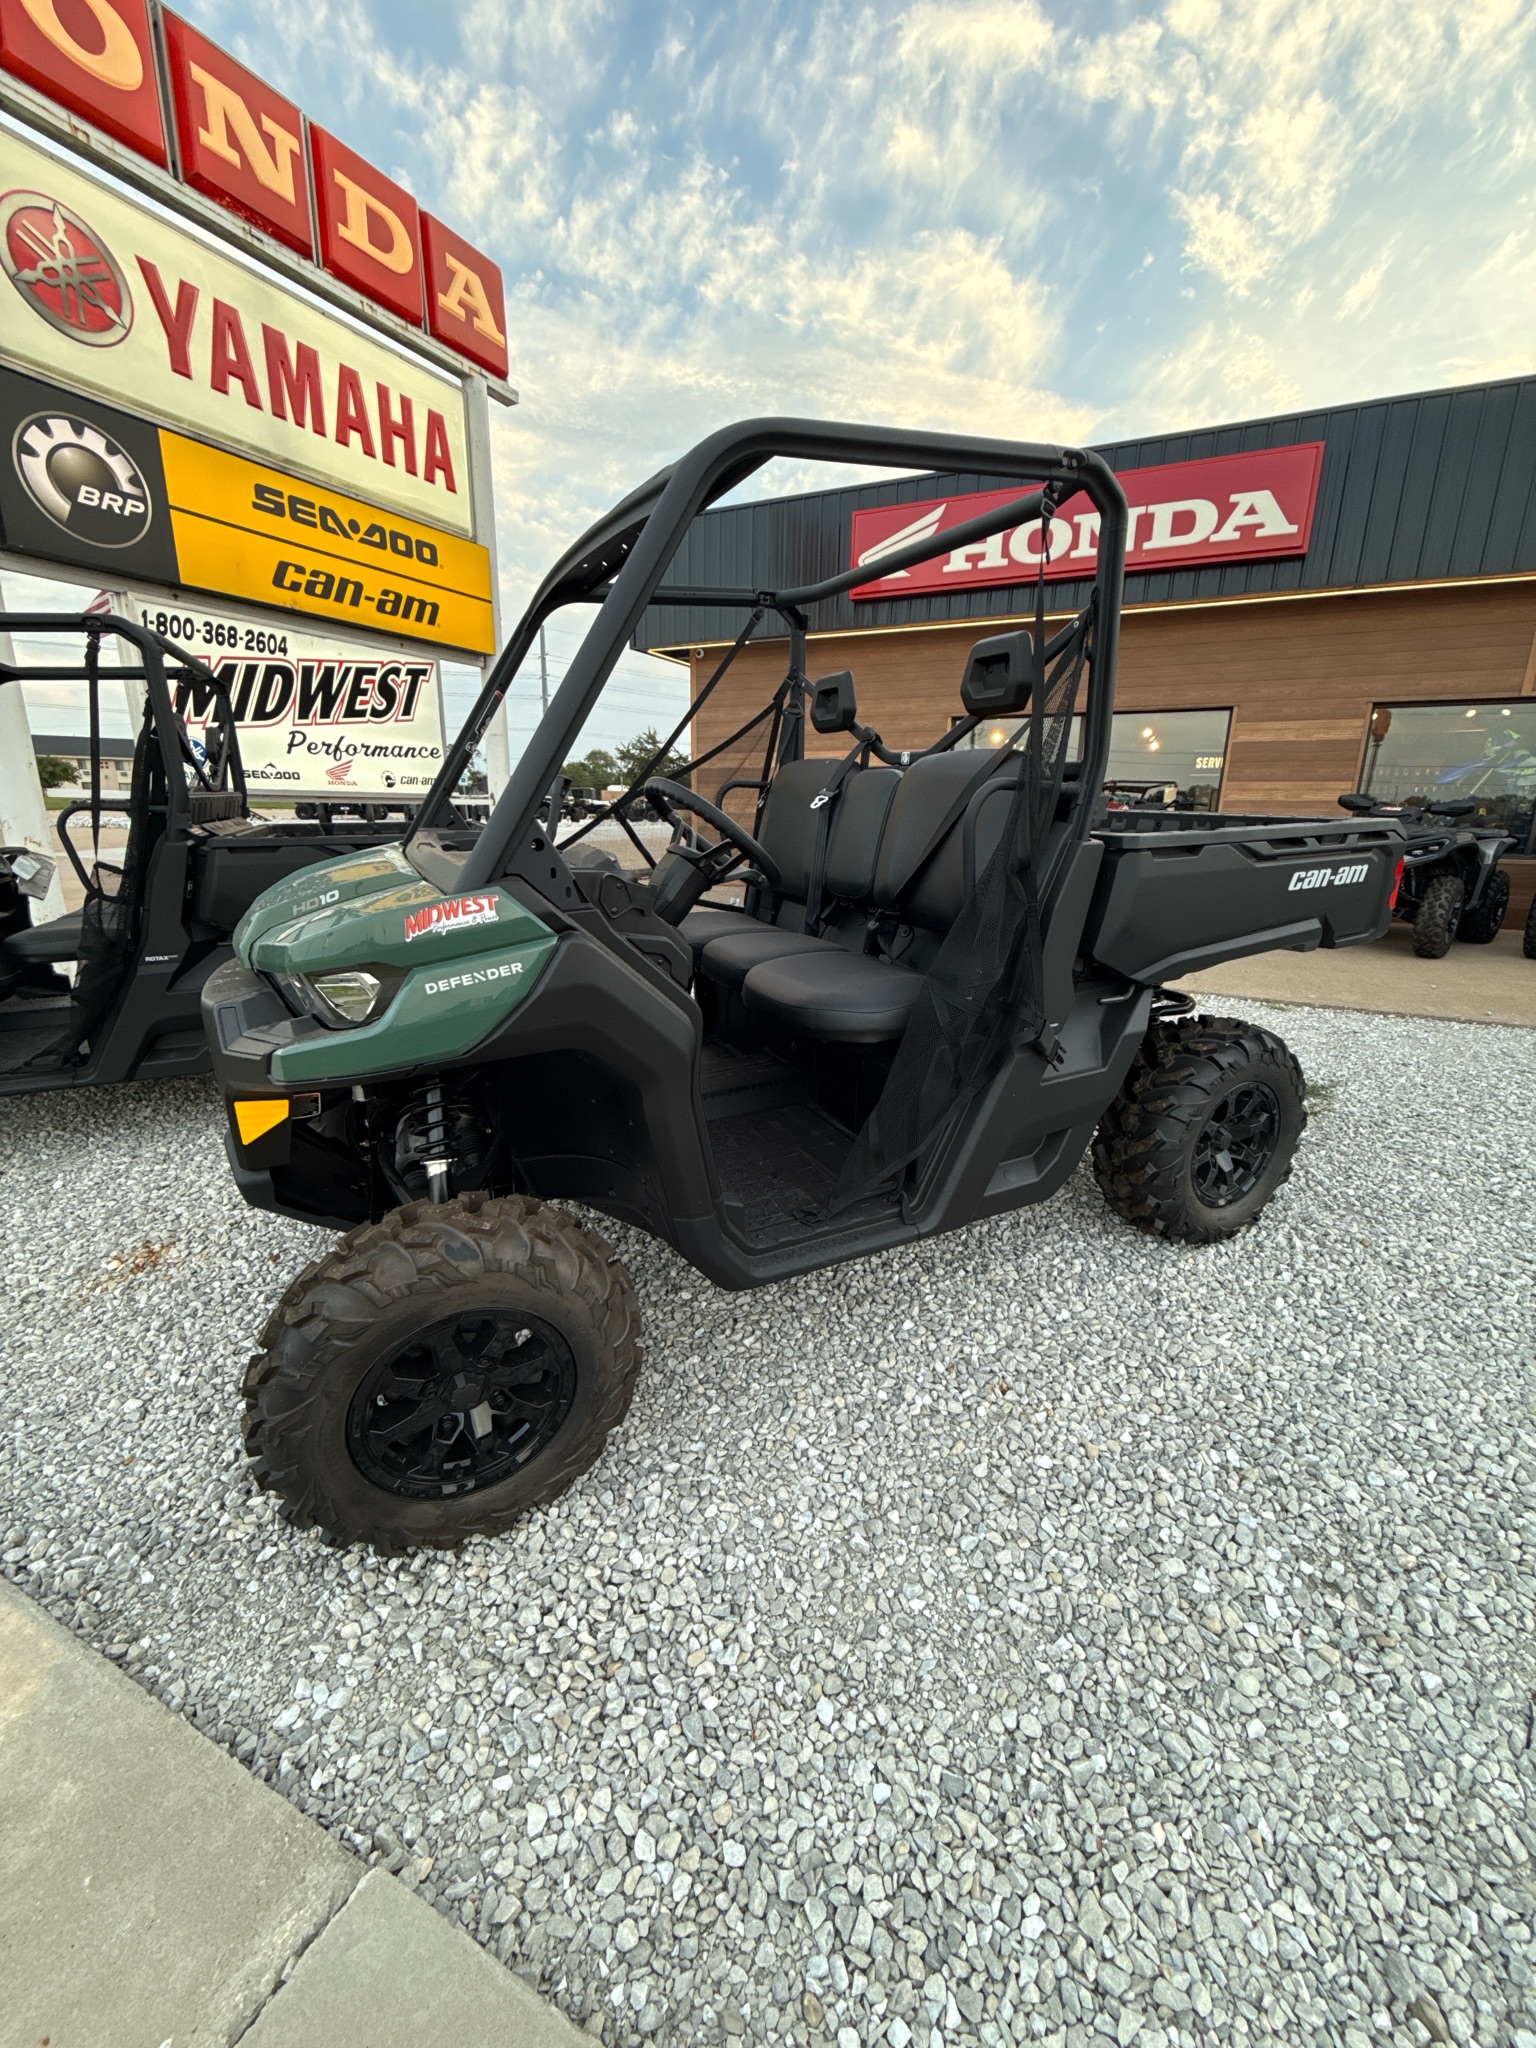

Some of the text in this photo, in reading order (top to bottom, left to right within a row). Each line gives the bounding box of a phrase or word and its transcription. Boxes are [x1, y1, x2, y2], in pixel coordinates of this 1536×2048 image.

[135, 254, 457, 494] YAMAHA
[77, 485, 145, 516] BRP
[141, 609, 288, 656] 1-800-368-2604
[176, 660, 431, 726] MIDWEST
[287, 731, 441, 761] Performance
[292, 889, 339, 916] HD10
[405, 895, 499, 940] MIDWEST
[432, 919, 470, 934] Performance
[425, 962, 523, 994] DEFENDER
